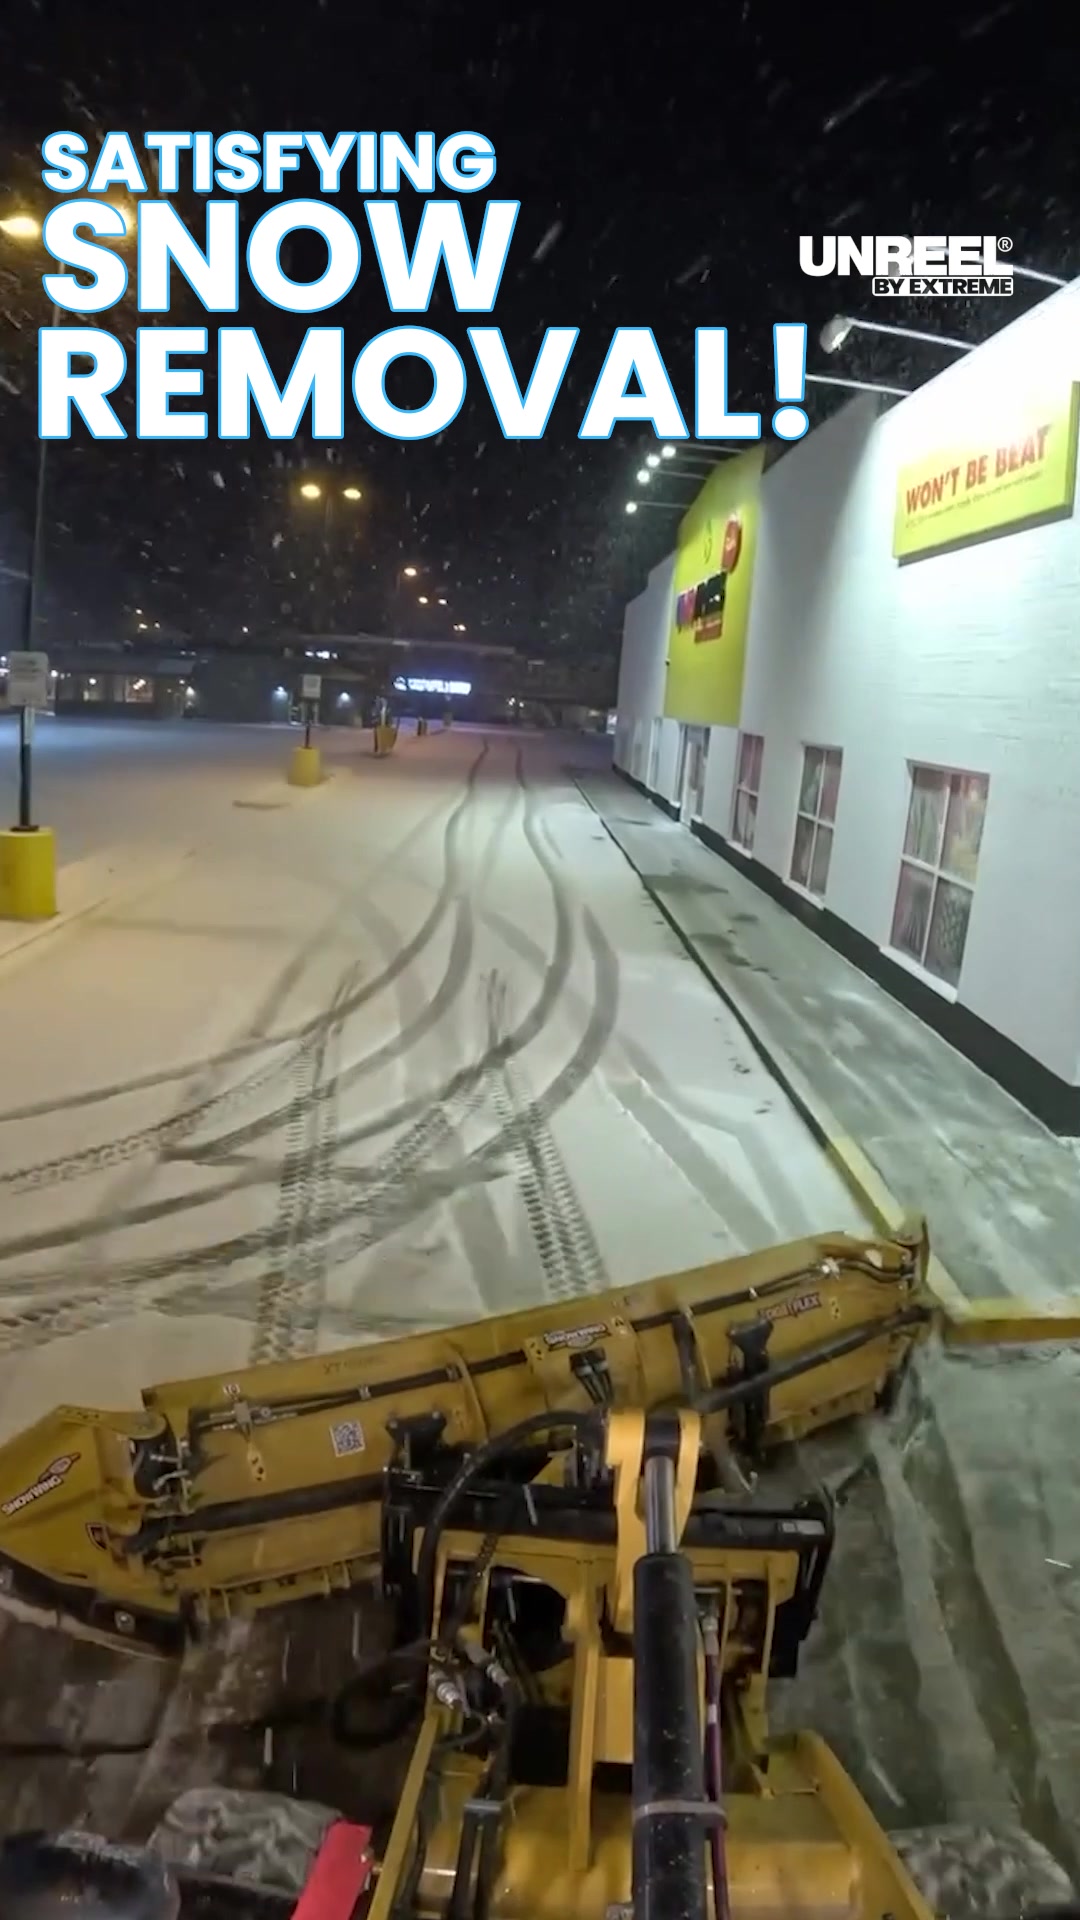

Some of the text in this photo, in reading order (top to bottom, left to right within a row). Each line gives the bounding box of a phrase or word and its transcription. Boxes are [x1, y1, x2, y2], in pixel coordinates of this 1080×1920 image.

[905, 468, 960, 514] WON'T
[966, 454, 988, 490] BE
[995, 425, 1050, 478] BEAT
